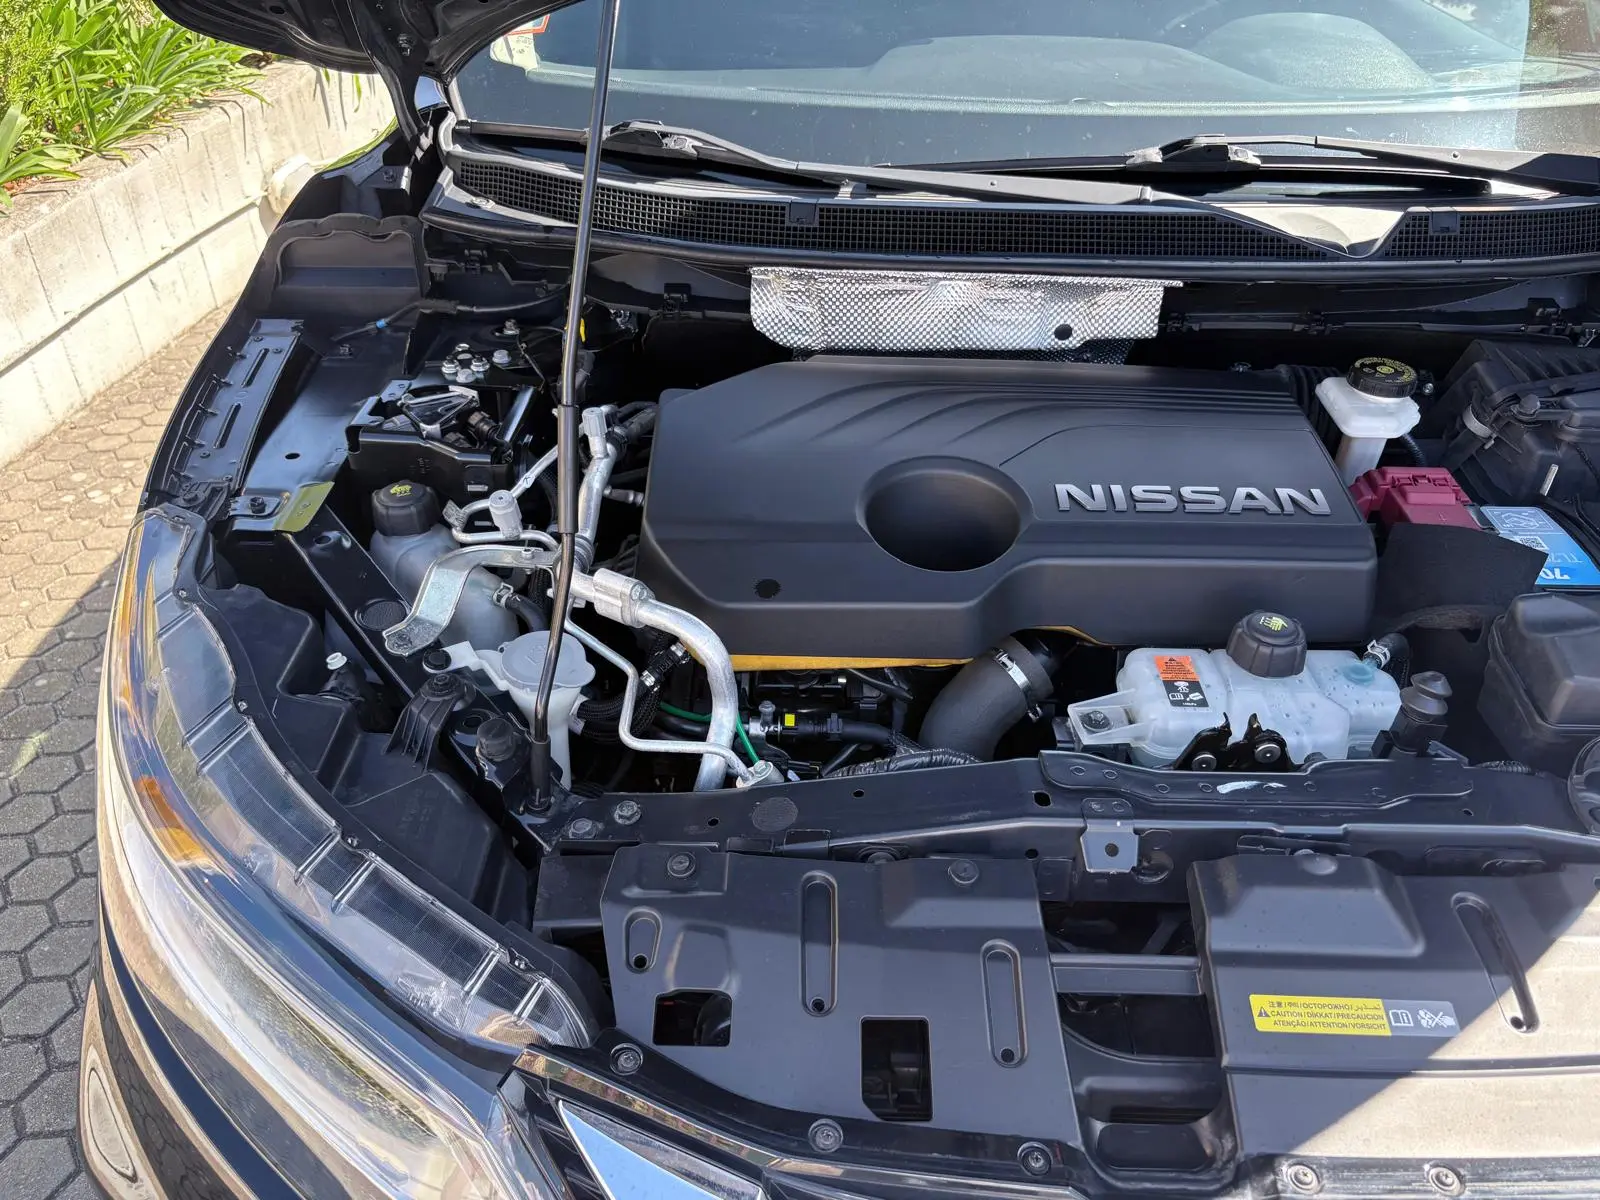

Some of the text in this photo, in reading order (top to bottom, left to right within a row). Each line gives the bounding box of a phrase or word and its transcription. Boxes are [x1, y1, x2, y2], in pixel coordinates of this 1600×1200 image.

[1055, 484, 1331, 515] NISSAN
[1270, 1010, 1303, 1018] CAUTION
[1309, 1021, 1347, 1029] ATTENTION
[1350, 1022, 1386, 1030] VORSICHT
